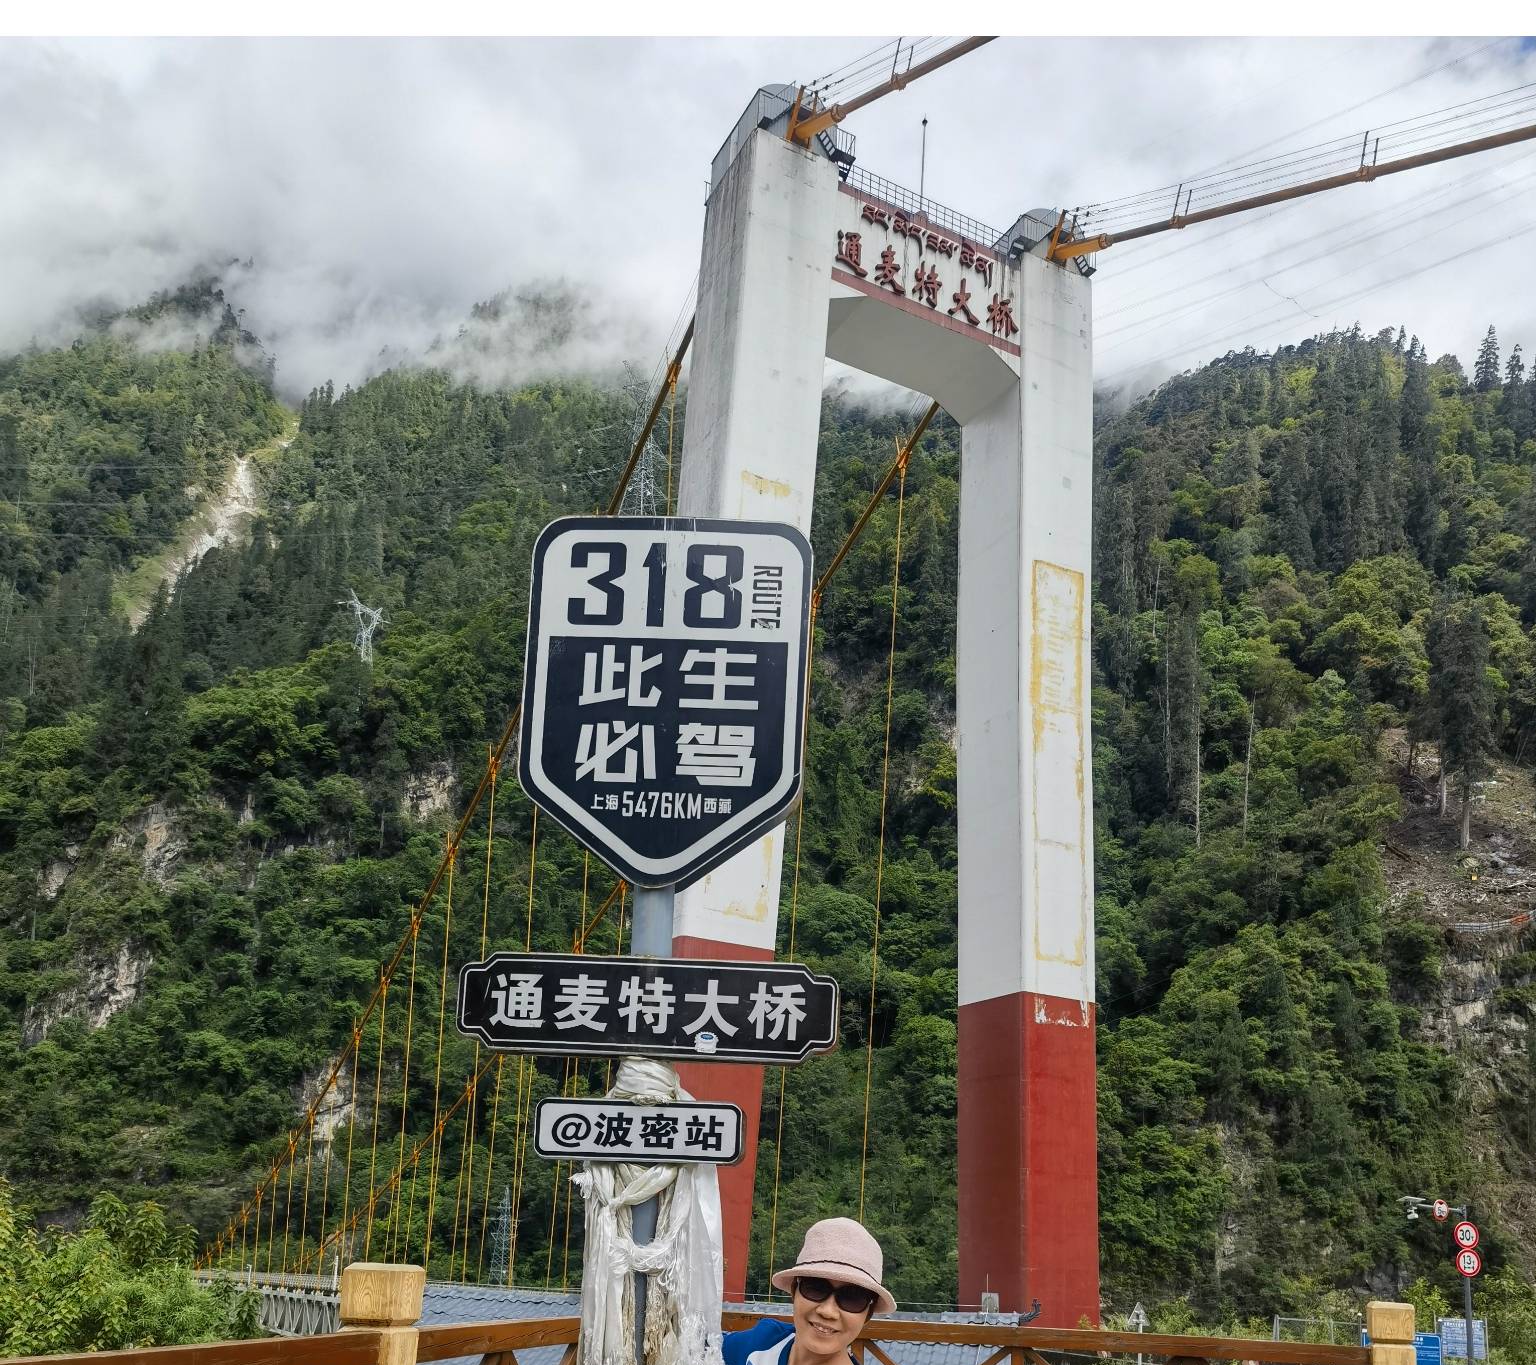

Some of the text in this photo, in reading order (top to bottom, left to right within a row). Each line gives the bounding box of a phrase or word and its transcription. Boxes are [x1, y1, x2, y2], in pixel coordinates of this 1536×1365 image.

[835, 229, 1019, 338] 通麦特大桥
[567, 542, 744, 630] 318
[751, 565, 782, 629] ROUTE
[579, 644, 759, 712] 此生
[574, 721, 757, 787] 必驾
[490, 972, 807, 1043] 通麦特大桥
[550, 1111, 725, 1153] @波密站
